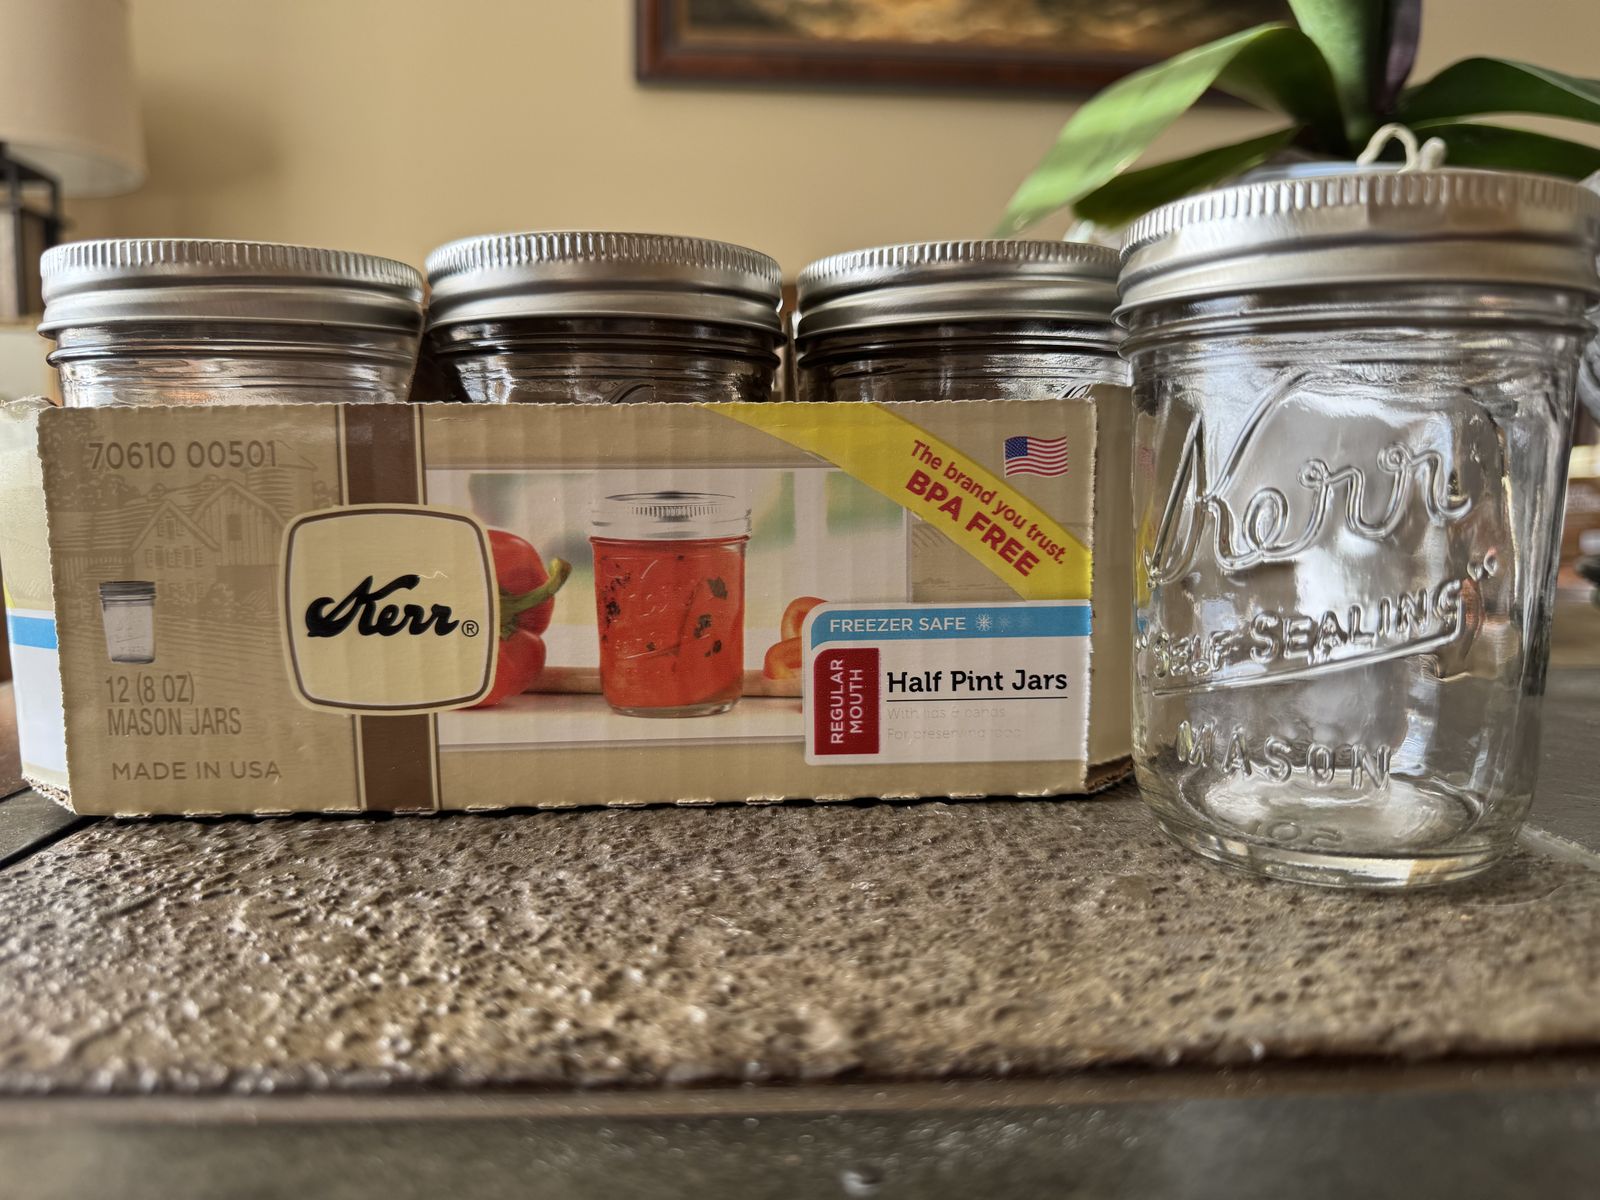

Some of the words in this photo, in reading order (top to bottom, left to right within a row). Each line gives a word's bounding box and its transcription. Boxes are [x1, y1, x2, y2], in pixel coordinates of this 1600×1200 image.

[89, 441, 175, 470] 70610
[187, 439, 277, 468] 00501
[910, 439, 943, 470] The
[943, 461, 998, 506] brand
[991, 500, 1028, 530] you
[1025, 523, 1067, 565] trust.
[905, 468, 963, 523] BPA
[964, 510, 1041, 577] FREE
[830, 617, 914, 633] FREEZER
[919, 616, 967, 631] SAFE
[105, 676, 130, 703] 12
[136, 671, 156, 706] (8
[162, 671, 195, 705] OZ)
[886, 670, 943, 693] Half
[950, 669, 1004, 692] Pint
[1011, 668, 1068, 692] Jars
[830, 659, 844, 745] REGULAR
[849, 669, 863, 734] MOUTH
[107, 708, 182, 736] MASON
[190, 707, 242, 735] JARS
[112, 762, 187, 781] MADE
[196, 761, 221, 779] IN
[230, 760, 283, 779] USA
